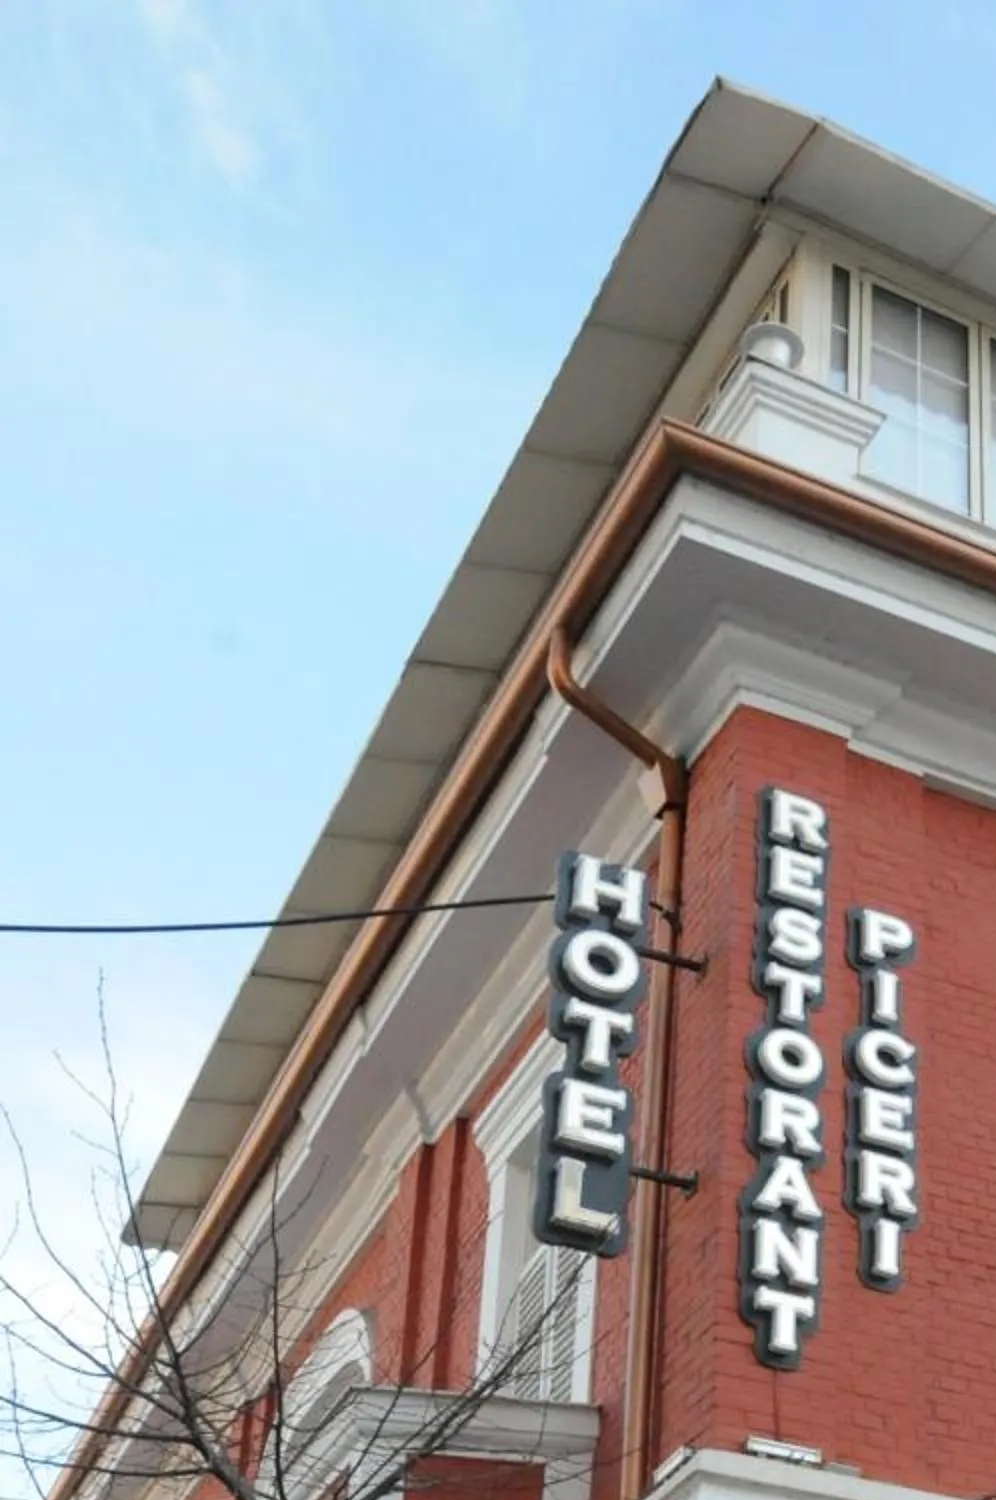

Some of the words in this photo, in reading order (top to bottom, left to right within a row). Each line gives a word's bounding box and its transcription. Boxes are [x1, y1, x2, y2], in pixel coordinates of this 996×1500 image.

[551, 854, 645, 1236] HOTEL
[752, 789, 828, 1353] RESTORANT
[856, 907, 917, 1279] PICERI
